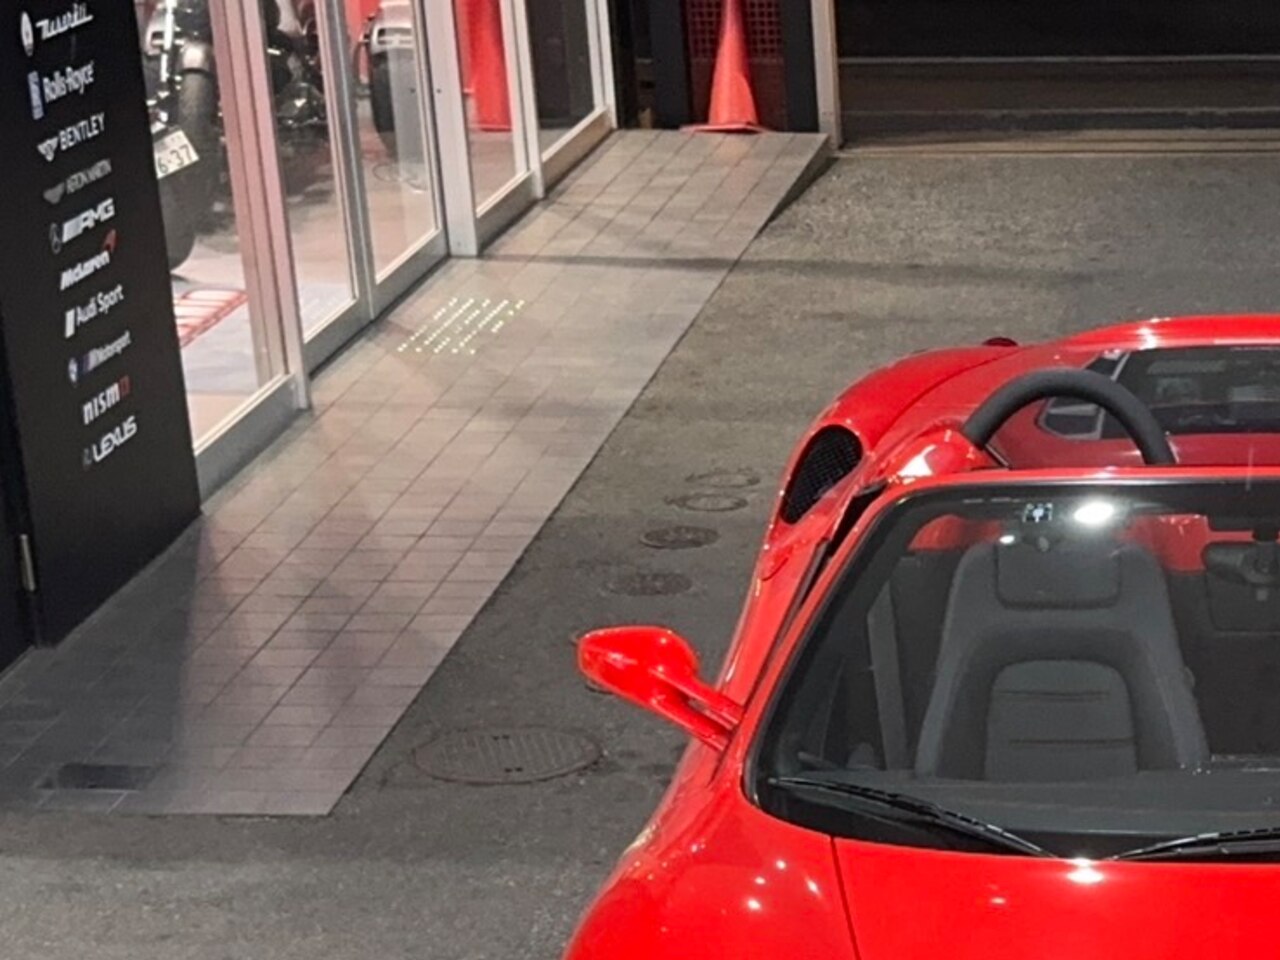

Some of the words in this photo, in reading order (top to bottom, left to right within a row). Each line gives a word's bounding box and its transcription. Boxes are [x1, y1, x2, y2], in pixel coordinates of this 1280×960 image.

[59, 112, 105, 150] BENTLEY
[76, 296, 97, 326] Audi
[97, 284, 124, 314] Sport
[92, 415, 138, 461] LEXUS
